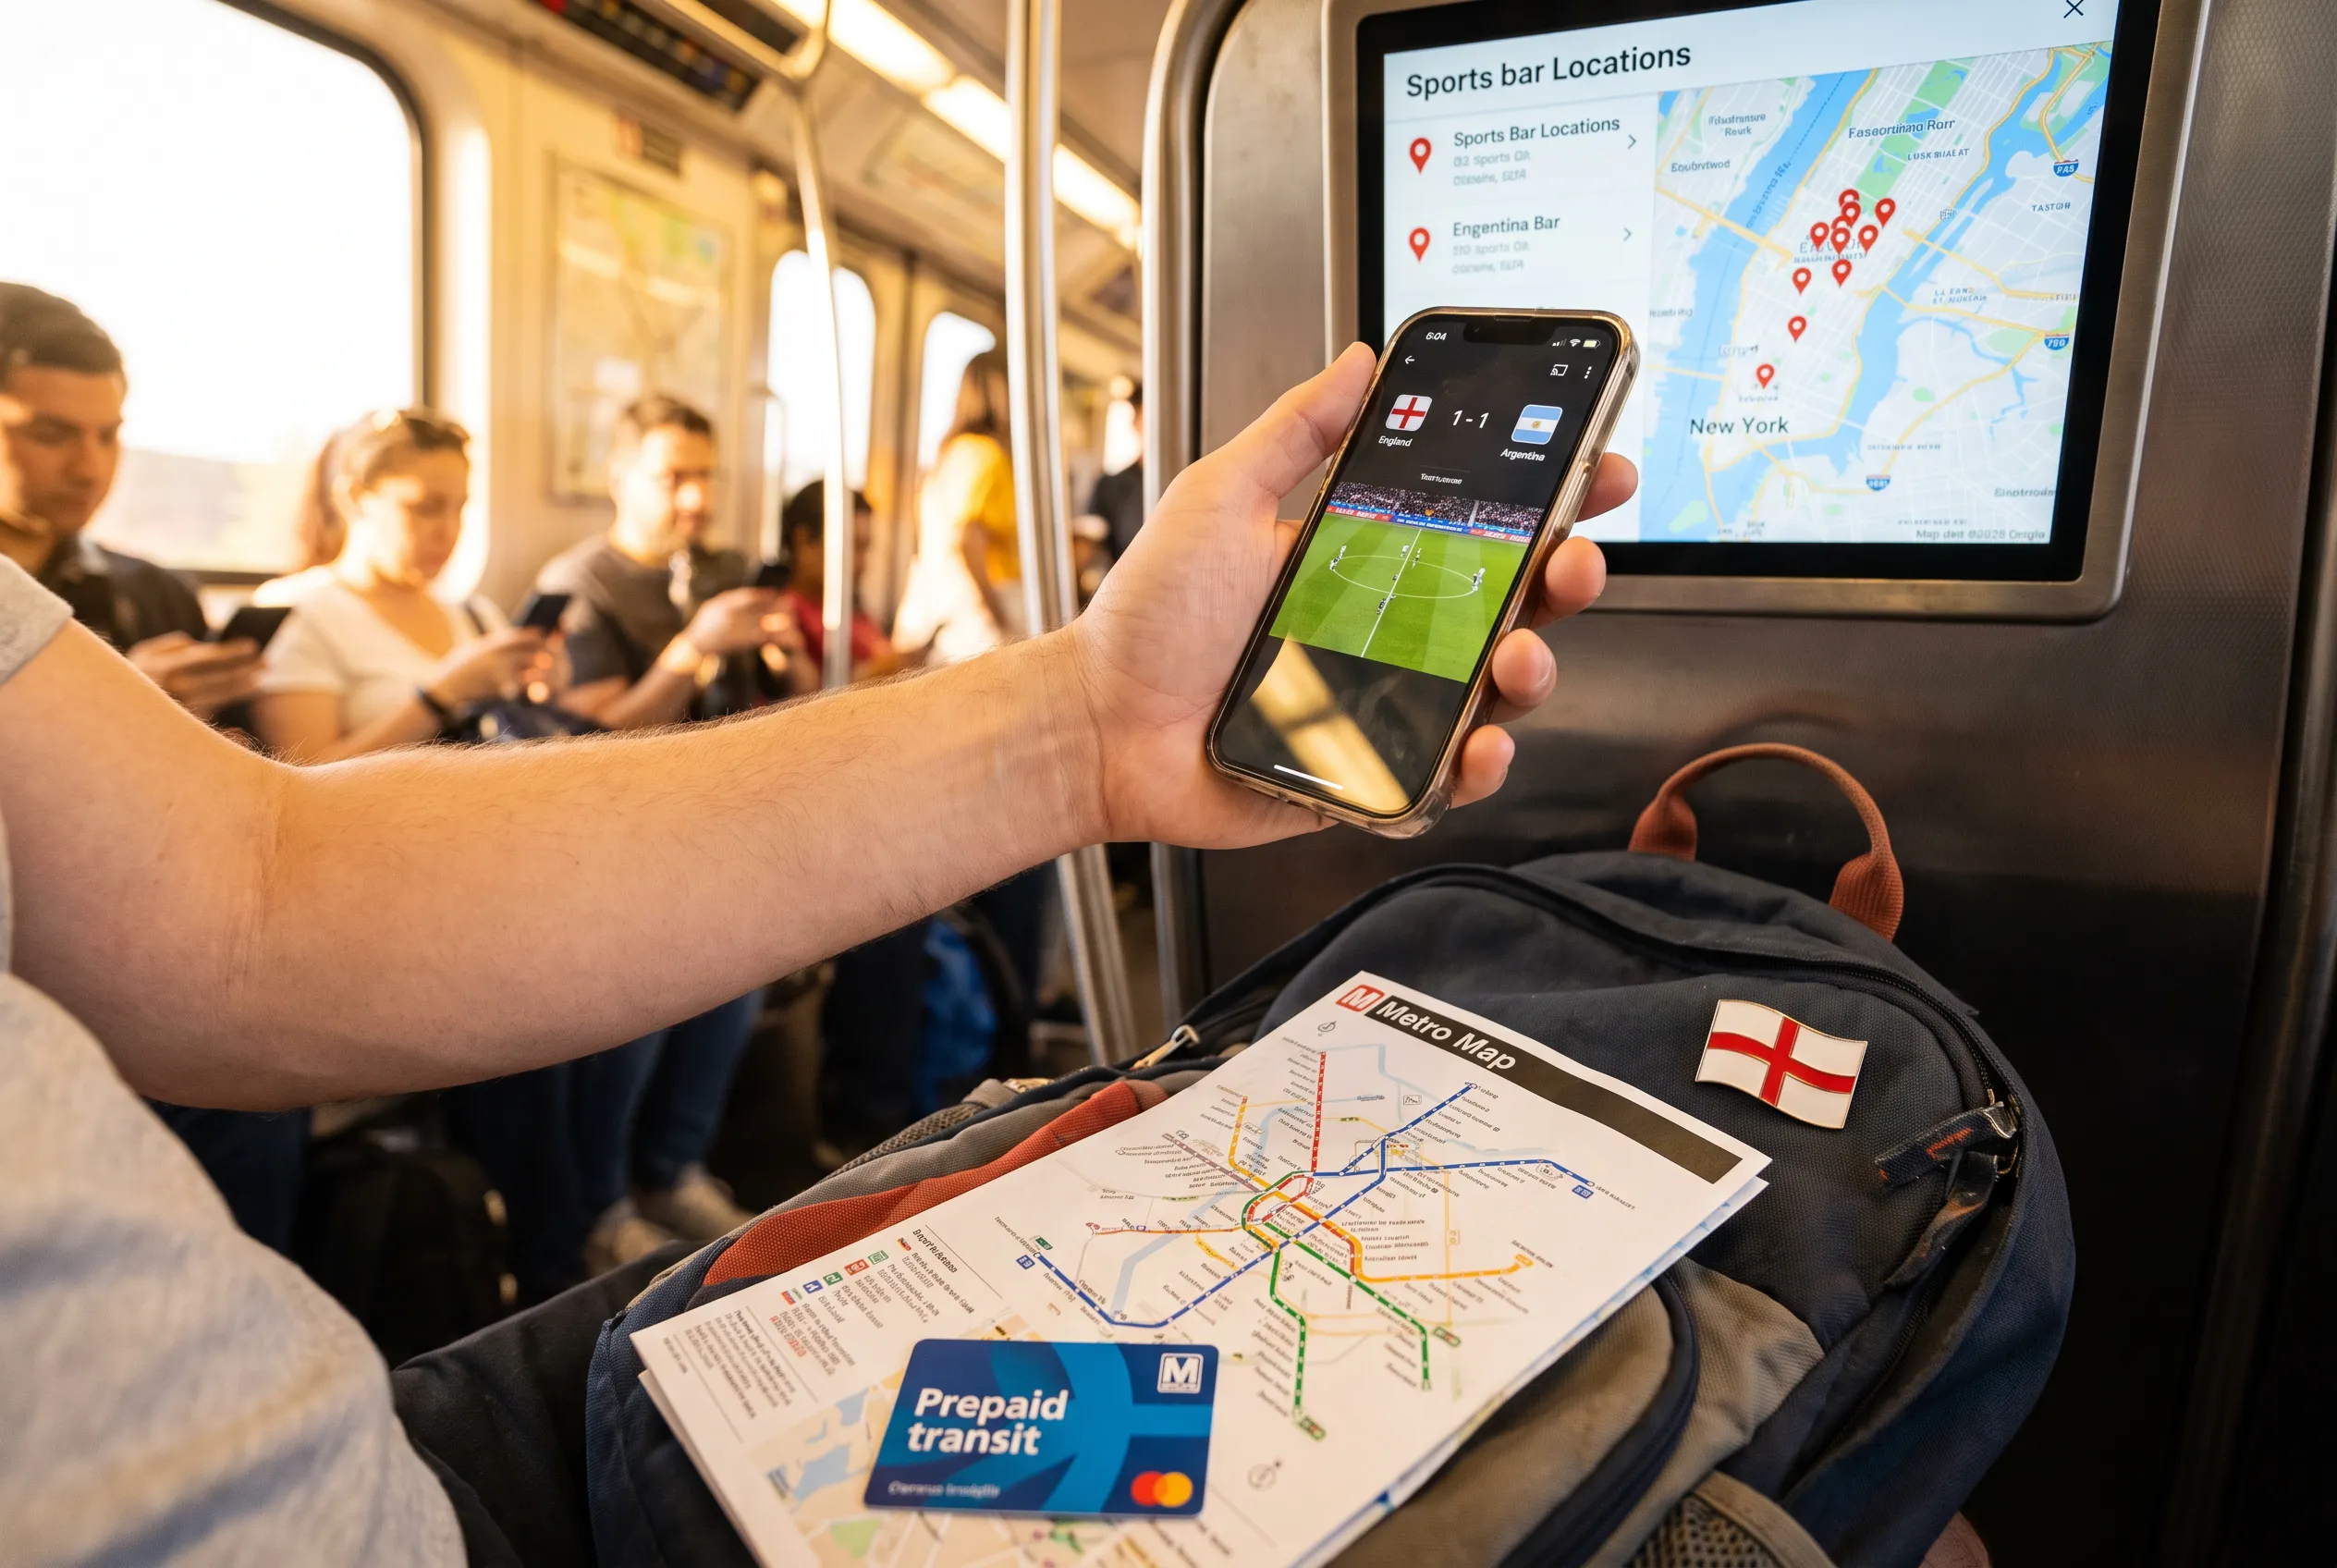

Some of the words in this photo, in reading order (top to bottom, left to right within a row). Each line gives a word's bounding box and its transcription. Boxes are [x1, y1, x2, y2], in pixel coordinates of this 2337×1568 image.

[1406, 67, 1493, 101] Sports
[1501, 62, 1544, 87] bar
[1553, 46, 1691, 80] Locations
[1454, 129, 1504, 148] Sports
[1510, 126, 1536, 141] Bar
[1540, 117, 1621, 138] Locations
[1453, 217, 1529, 239] Engentina
[1535, 215, 1560, 230] Bar
[1690, 418, 1734, 435] New
[1743, 416, 1789, 435] York
[1377, 435, 1413, 447] England
[1499, 448, 1546, 462] Argentina
[1916, 529, 1939, 541] Map
[1340, 986, 1381, 1011] M
[1376, 1001, 1452, 1040] Metro
[1452, 1033, 1516, 1070] Map
[1161, 1356, 1201, 1384] M
[914, 1387, 1069, 1425] Prepaid
[908, 1422, 1042, 1456] transit
